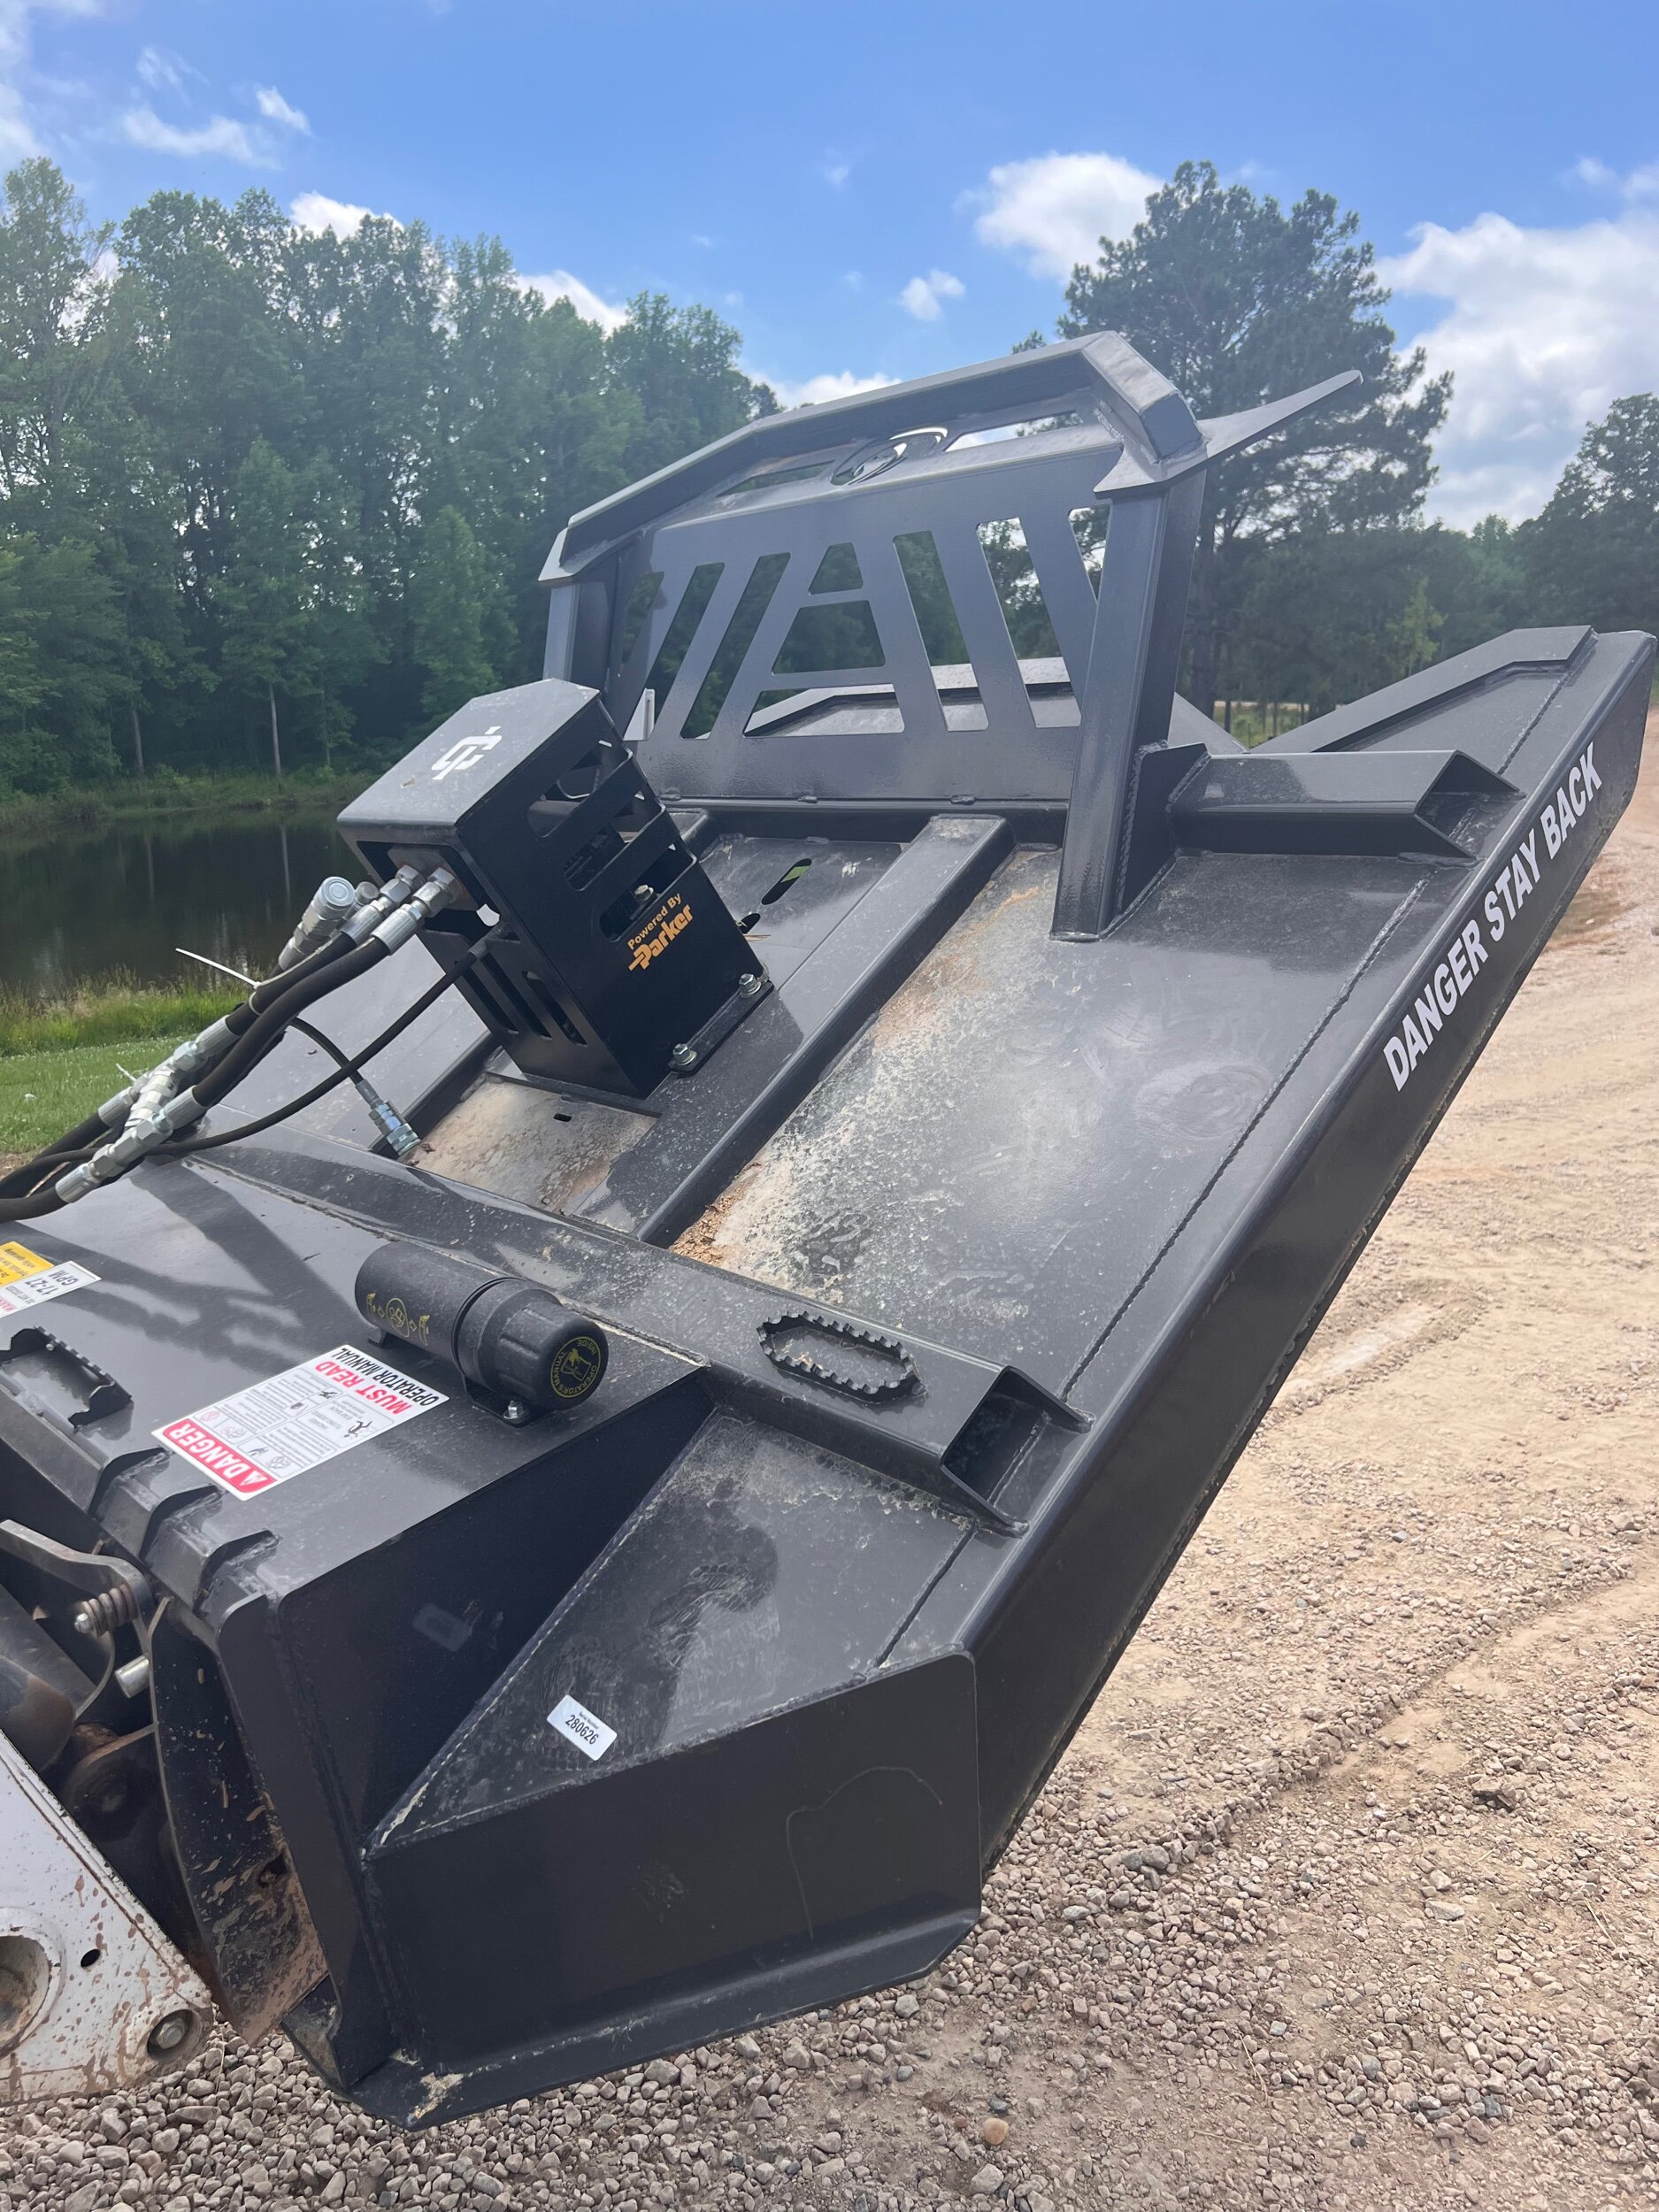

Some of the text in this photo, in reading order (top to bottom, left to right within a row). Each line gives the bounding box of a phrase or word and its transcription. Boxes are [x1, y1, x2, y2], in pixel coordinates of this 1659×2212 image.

[627, 893, 681, 949] Powered By
[628, 904, 693, 972] Parker
[1383, 741, 1602, 1092] DANGER STAY BACK
[49, 1270, 81, 1286] GPM
[577, 1339, 597, 1355] INSIDE
[314, 1360, 366, 1386] READ
[319, 1348, 440, 1406] OPERATOR MANUAL
[356, 1384, 412, 1415] MUST
[171, 1424, 248, 1479] DANGER
[565, 1715, 599, 1745] 280626
